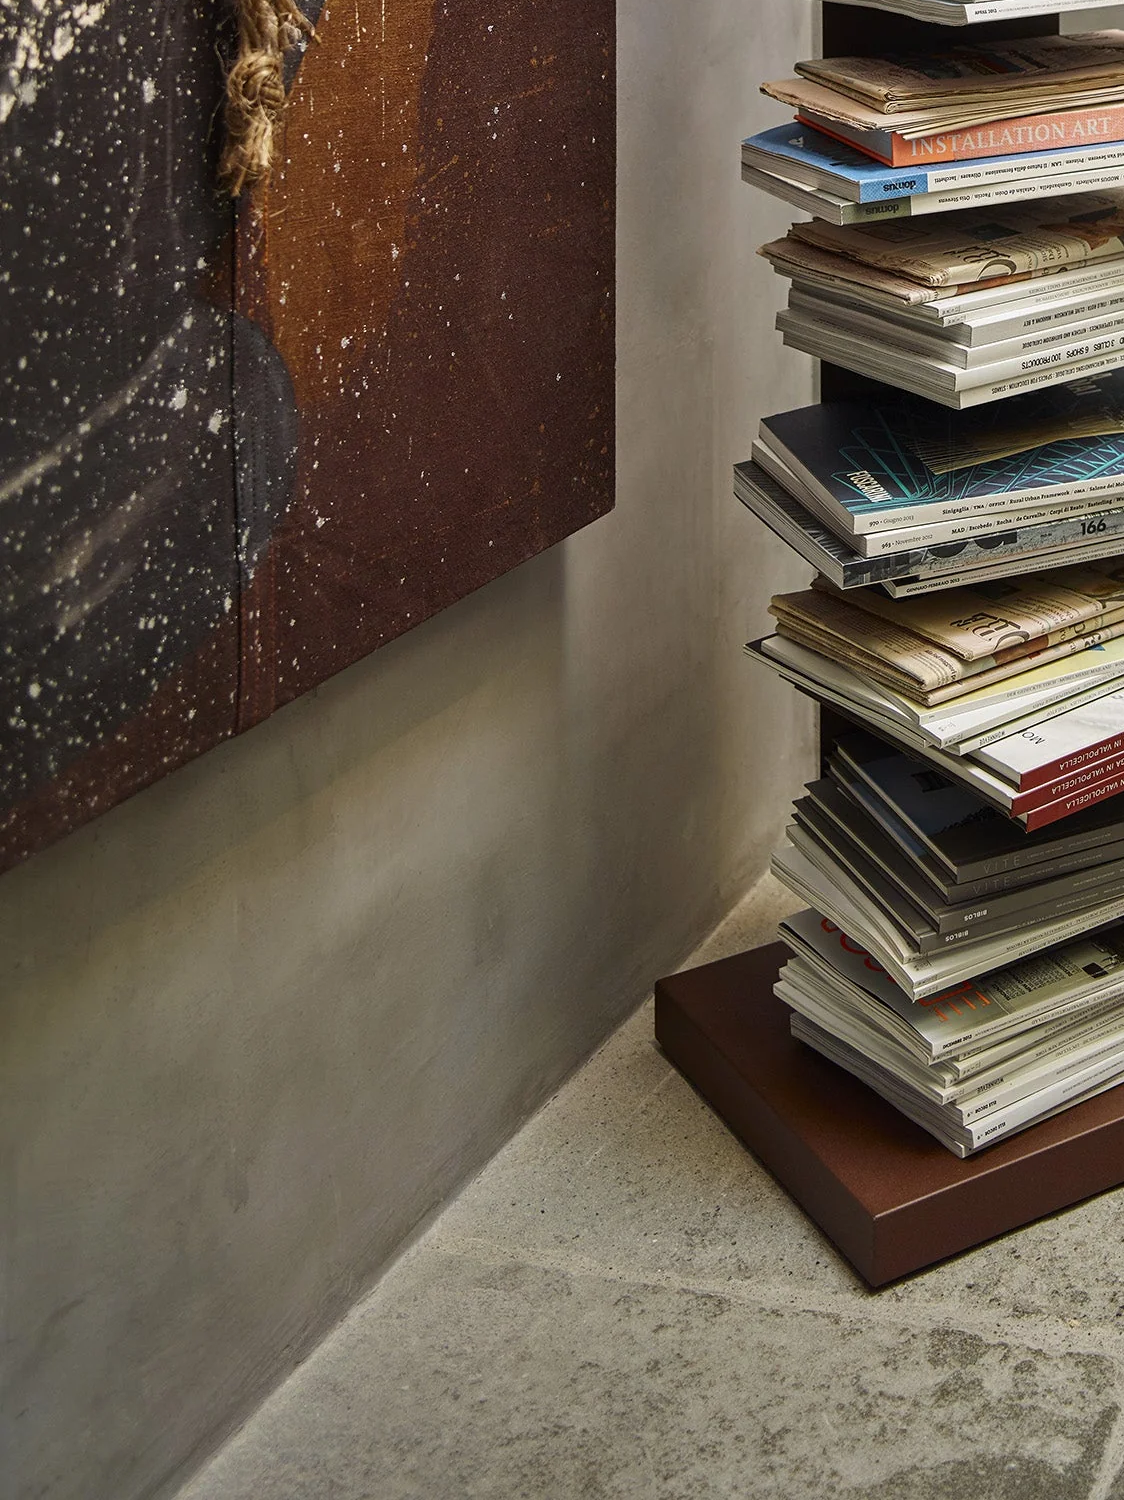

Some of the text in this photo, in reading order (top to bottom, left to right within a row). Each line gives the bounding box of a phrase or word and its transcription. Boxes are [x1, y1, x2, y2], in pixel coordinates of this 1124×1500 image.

[910, 116, 1111, 156] INSTALLATION ART
[882, 179, 917, 193] domus
[865, 203, 900, 216] domus
[1093, 339, 1110, 352] CLUBS
[1110, 338, 1114, 347] 3
[1066, 346, 1084, 359] SHOPS
[1084, 345, 1088, 354] 6
[1021, 354, 1050, 370] PRODUCTS
[1050, 352, 1061, 362] 100
[942, 504, 969, 516] Sinigaglia
[1009, 496, 1024, 504] Rural
[1024, 494, 1040, 502] Urban
[1040, 489, 1069, 499] Framework
[1089, 483, 1106, 492] Salone
[869, 519, 879, 527] 970
[883, 515, 902, 525] Giugno
[951, 526, 965, 535] MAD
[968, 521, 992, 531] Escobedo
[1022, 510, 1046, 521] Carvalho
[1080, 519, 1107, 536] 166
[881, 541, 891, 549] 963
[895, 534, 921, 546] Novembre
[1113, 737, 1121, 749] IN
[1059, 741, 1111, 771] VALPOLICELLA
[1106, 761, 1114, 773] IN
[1051, 765, 1104, 795] VALPOLICELLA
[1066, 779, 1118, 810] VALPOLICELLA
[964, 909, 988, 922] BIBLOS
[945, 930, 969, 942] BIBLOS
